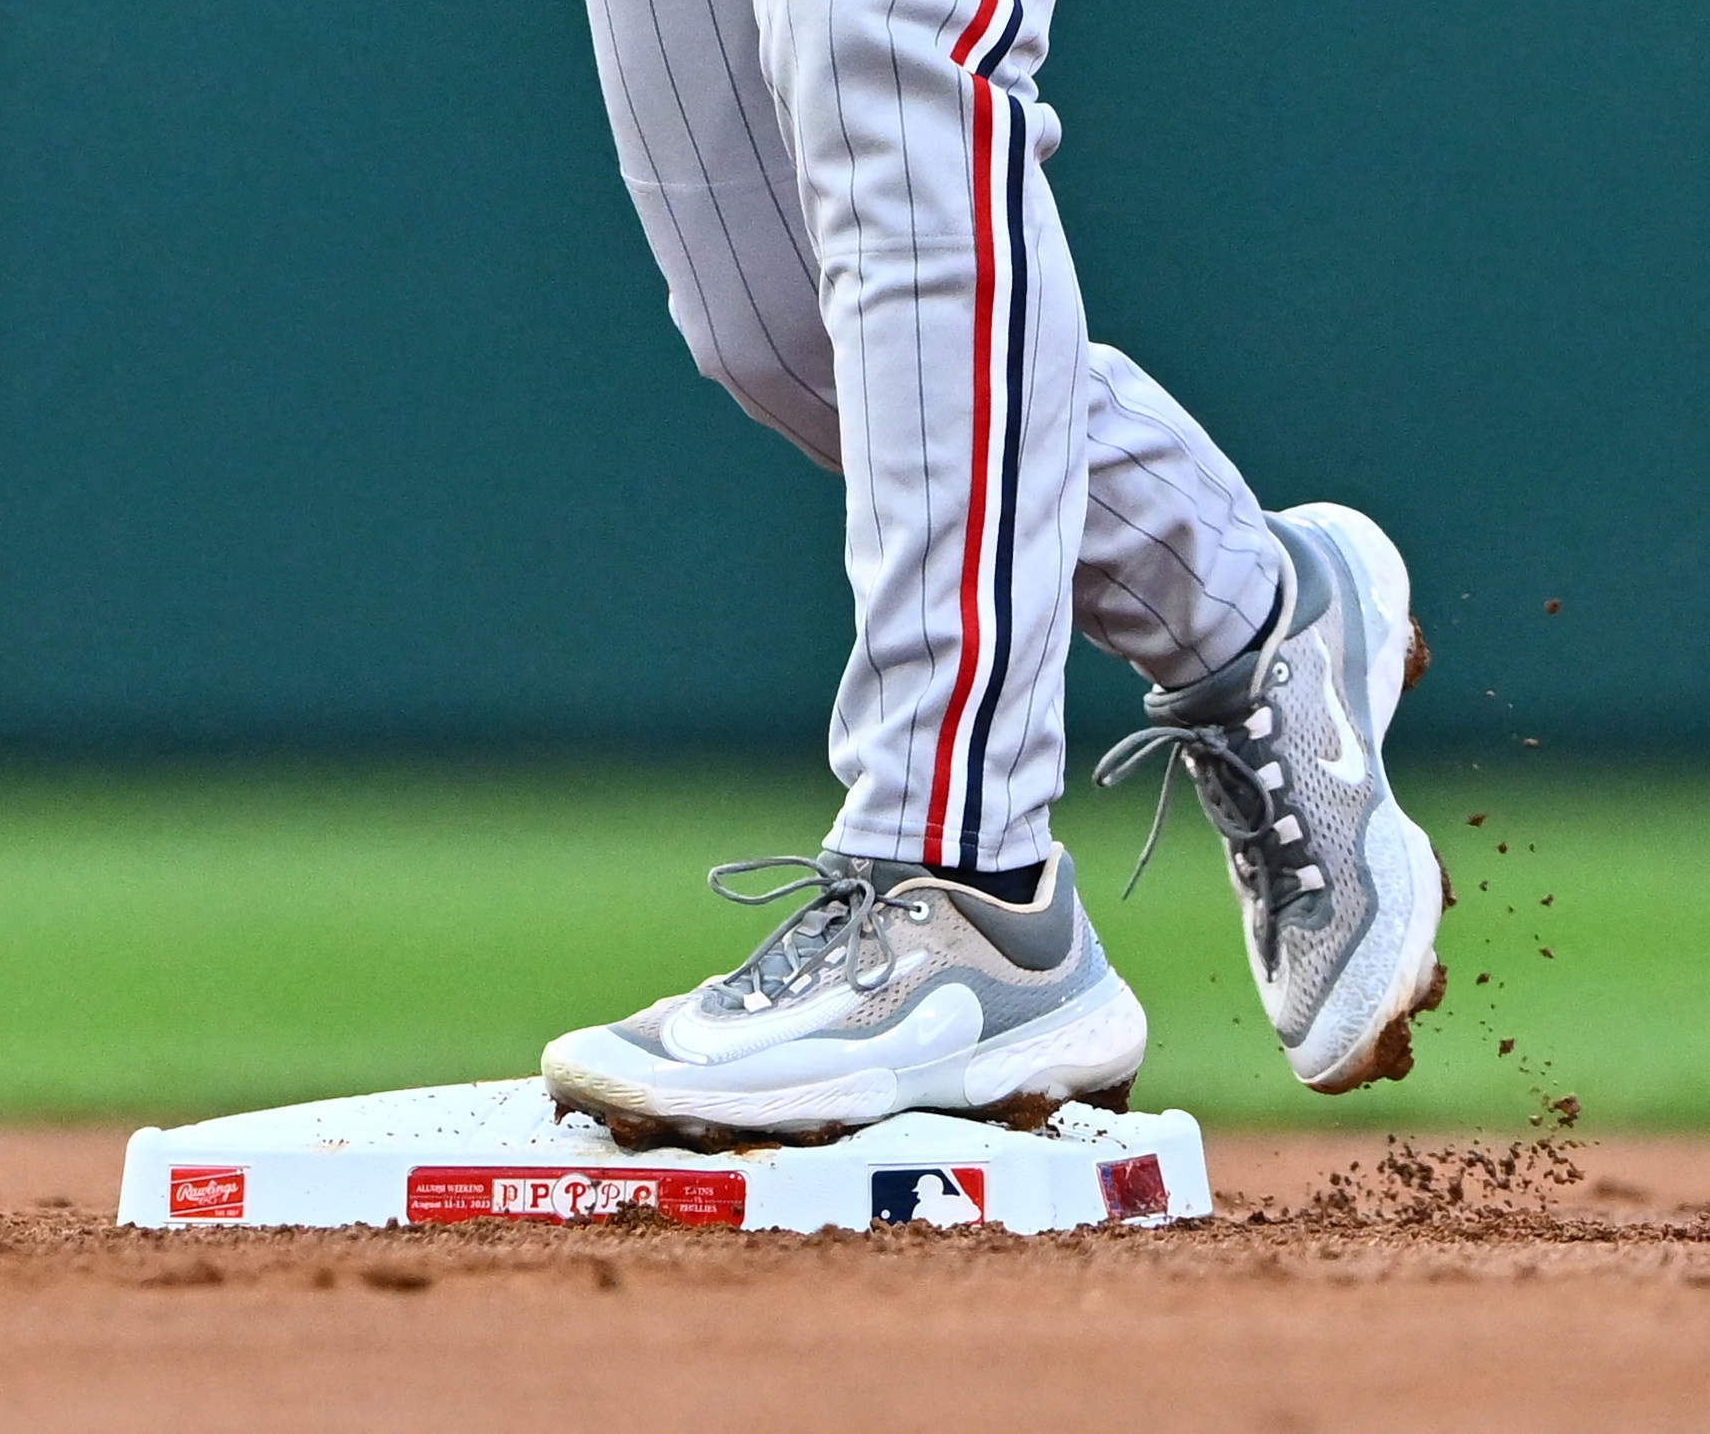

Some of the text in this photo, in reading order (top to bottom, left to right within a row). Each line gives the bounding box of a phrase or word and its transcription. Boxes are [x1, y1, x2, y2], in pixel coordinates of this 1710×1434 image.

[176, 1179, 238, 1202] Rawlings
[447, 1183, 484, 1193] WEEKEND
[410, 1199, 442, 1210] August
